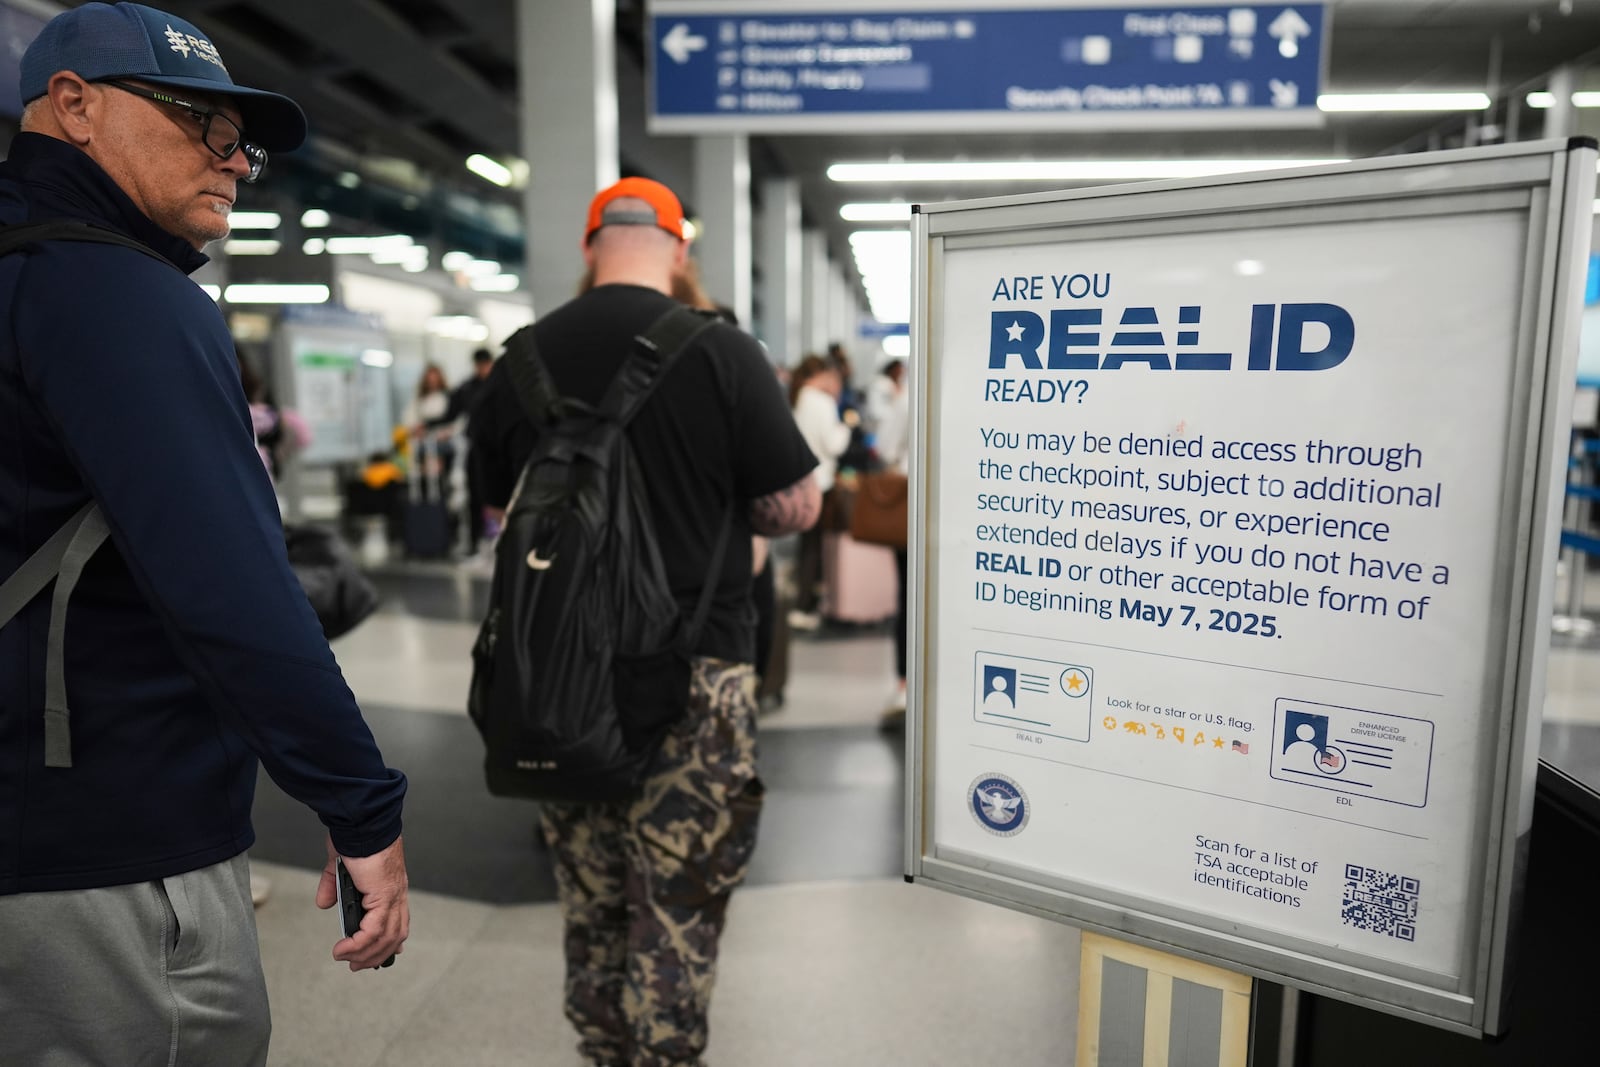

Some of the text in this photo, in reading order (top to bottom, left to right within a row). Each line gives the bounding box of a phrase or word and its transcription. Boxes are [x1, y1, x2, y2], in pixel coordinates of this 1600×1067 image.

[992, 273, 1111, 301] ARE YOU
[988, 302, 1355, 371] REAL ID
[985, 379, 1089, 404] READY?
[980, 427, 1422, 472] You may be denied access through
[978, 458, 1441, 508] the checkpoint, subject to additional
[977, 493, 1390, 542] security measures, or experience
[976, 523, 1449, 585] extended delays if you do not have a
[976, 551, 1431, 620] REAL ID or other acceptable form of
[976, 581, 1282, 639] ID beginning May 7, 2025.
[1107, 696, 1255, 732] Look for a star or U.S. flag.
[1359, 721, 1400, 734] ENHANCED
[1034, 736, 1043, 744] ID
[1350, 727, 1407, 743] DRIVER LICENSE
[1336, 796, 1353, 807] EDL
[1194, 853, 1309, 892] TSA acceptable
[1195, 835, 1319, 874] Scan for a list of
[1194, 871, 1301, 909] identifications
